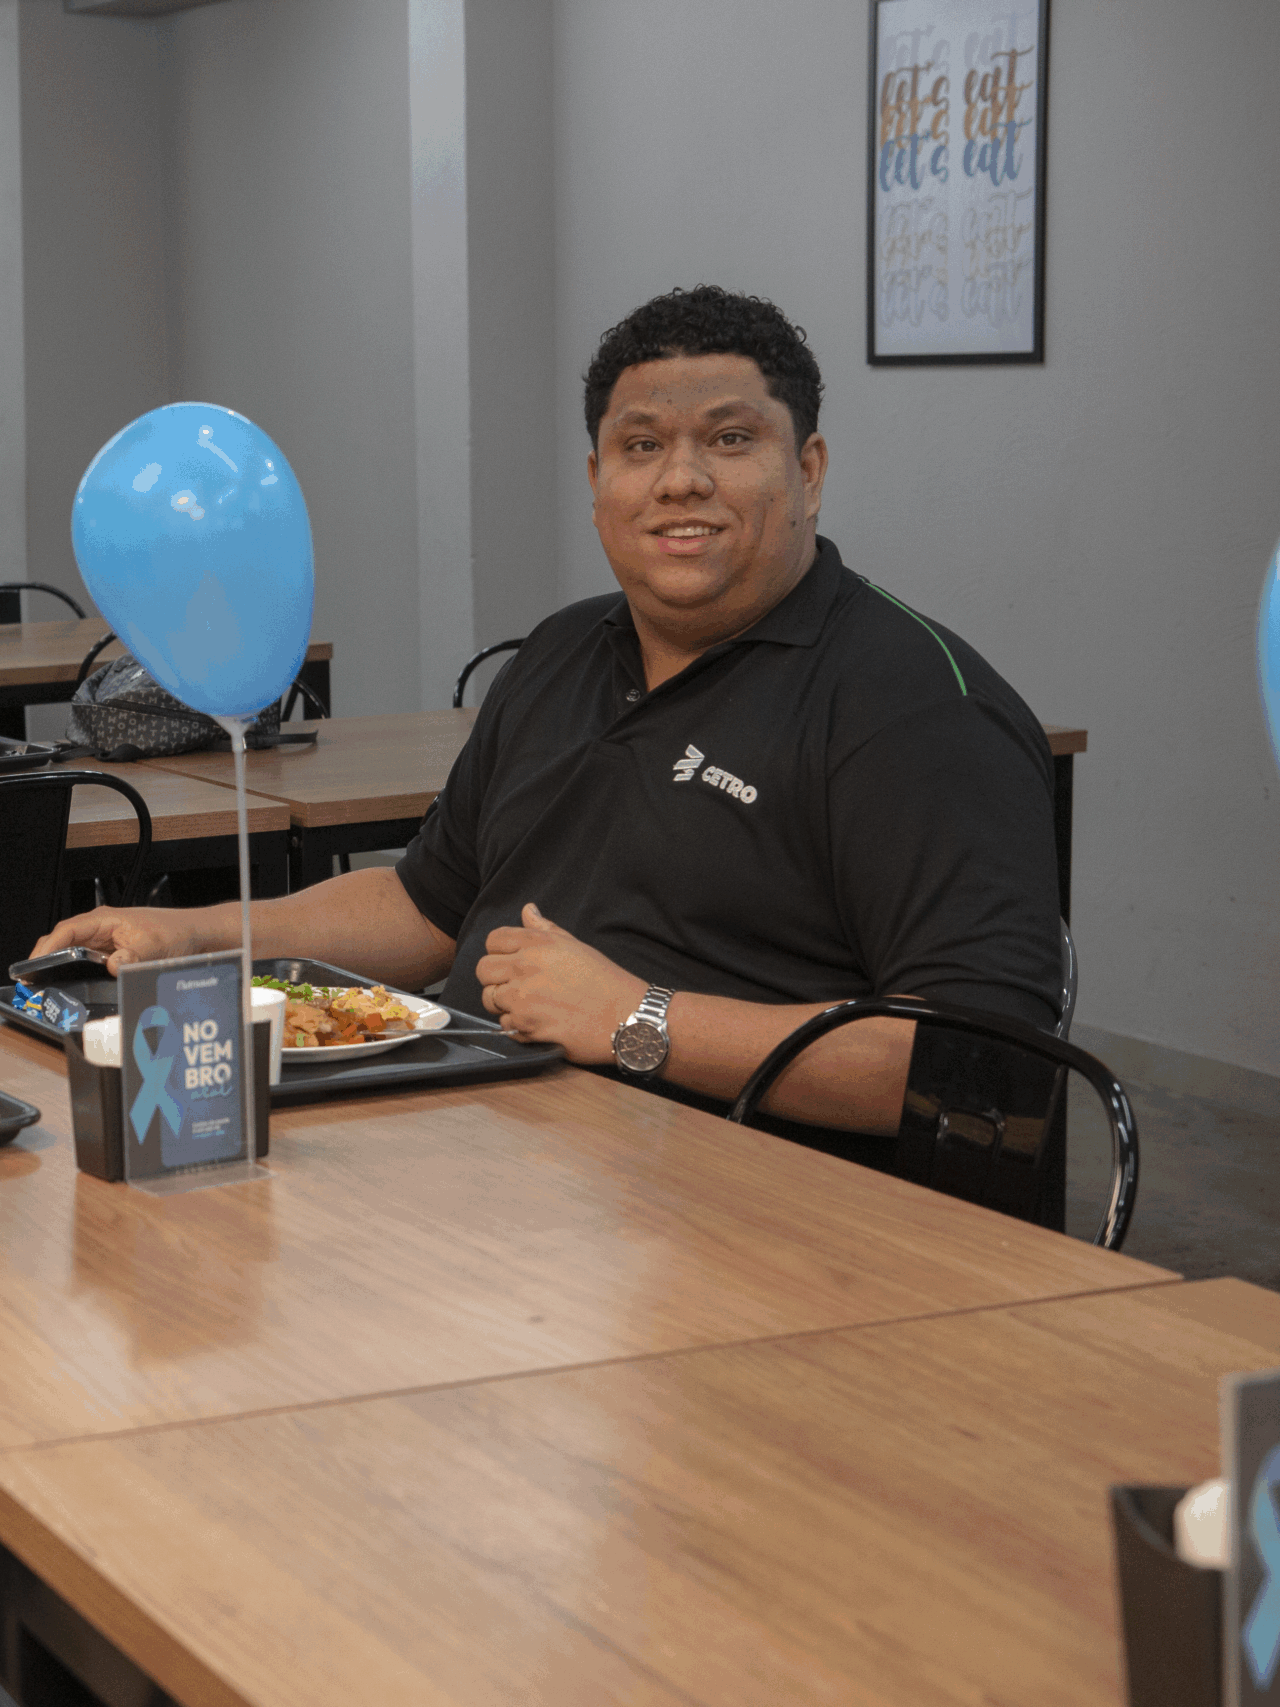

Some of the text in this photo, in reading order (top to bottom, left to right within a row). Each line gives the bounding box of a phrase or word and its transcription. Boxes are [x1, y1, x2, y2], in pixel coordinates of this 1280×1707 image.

[963, 117, 1033, 187] eat
[702, 765, 758, 804] CETRO
[183, 1019, 218, 1044] NO
[184, 1039, 234, 1066] VEM
[185, 1062, 232, 1090] BRO
